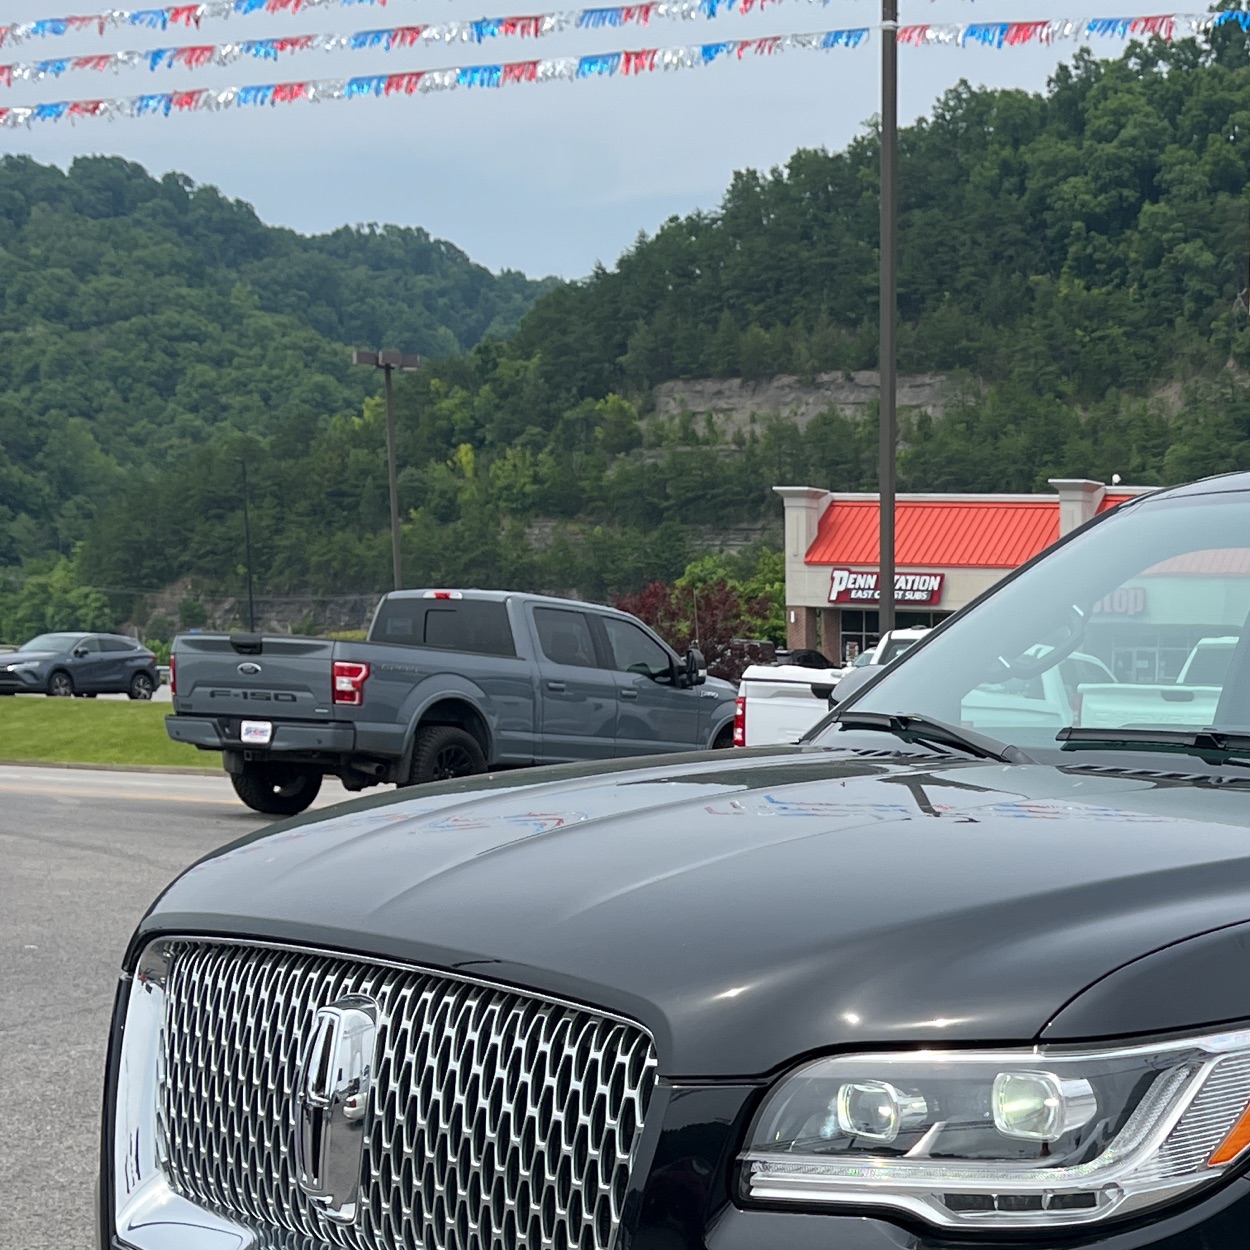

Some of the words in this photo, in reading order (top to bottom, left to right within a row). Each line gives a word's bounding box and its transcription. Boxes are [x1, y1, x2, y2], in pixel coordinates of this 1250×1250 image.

[829, 570, 878, 601] PENN
[893, 574, 941, 591] TATION
[850, 590, 873, 599] EAST
[904, 591, 928, 600] SUBS
[209, 689, 297, 703] F-150
